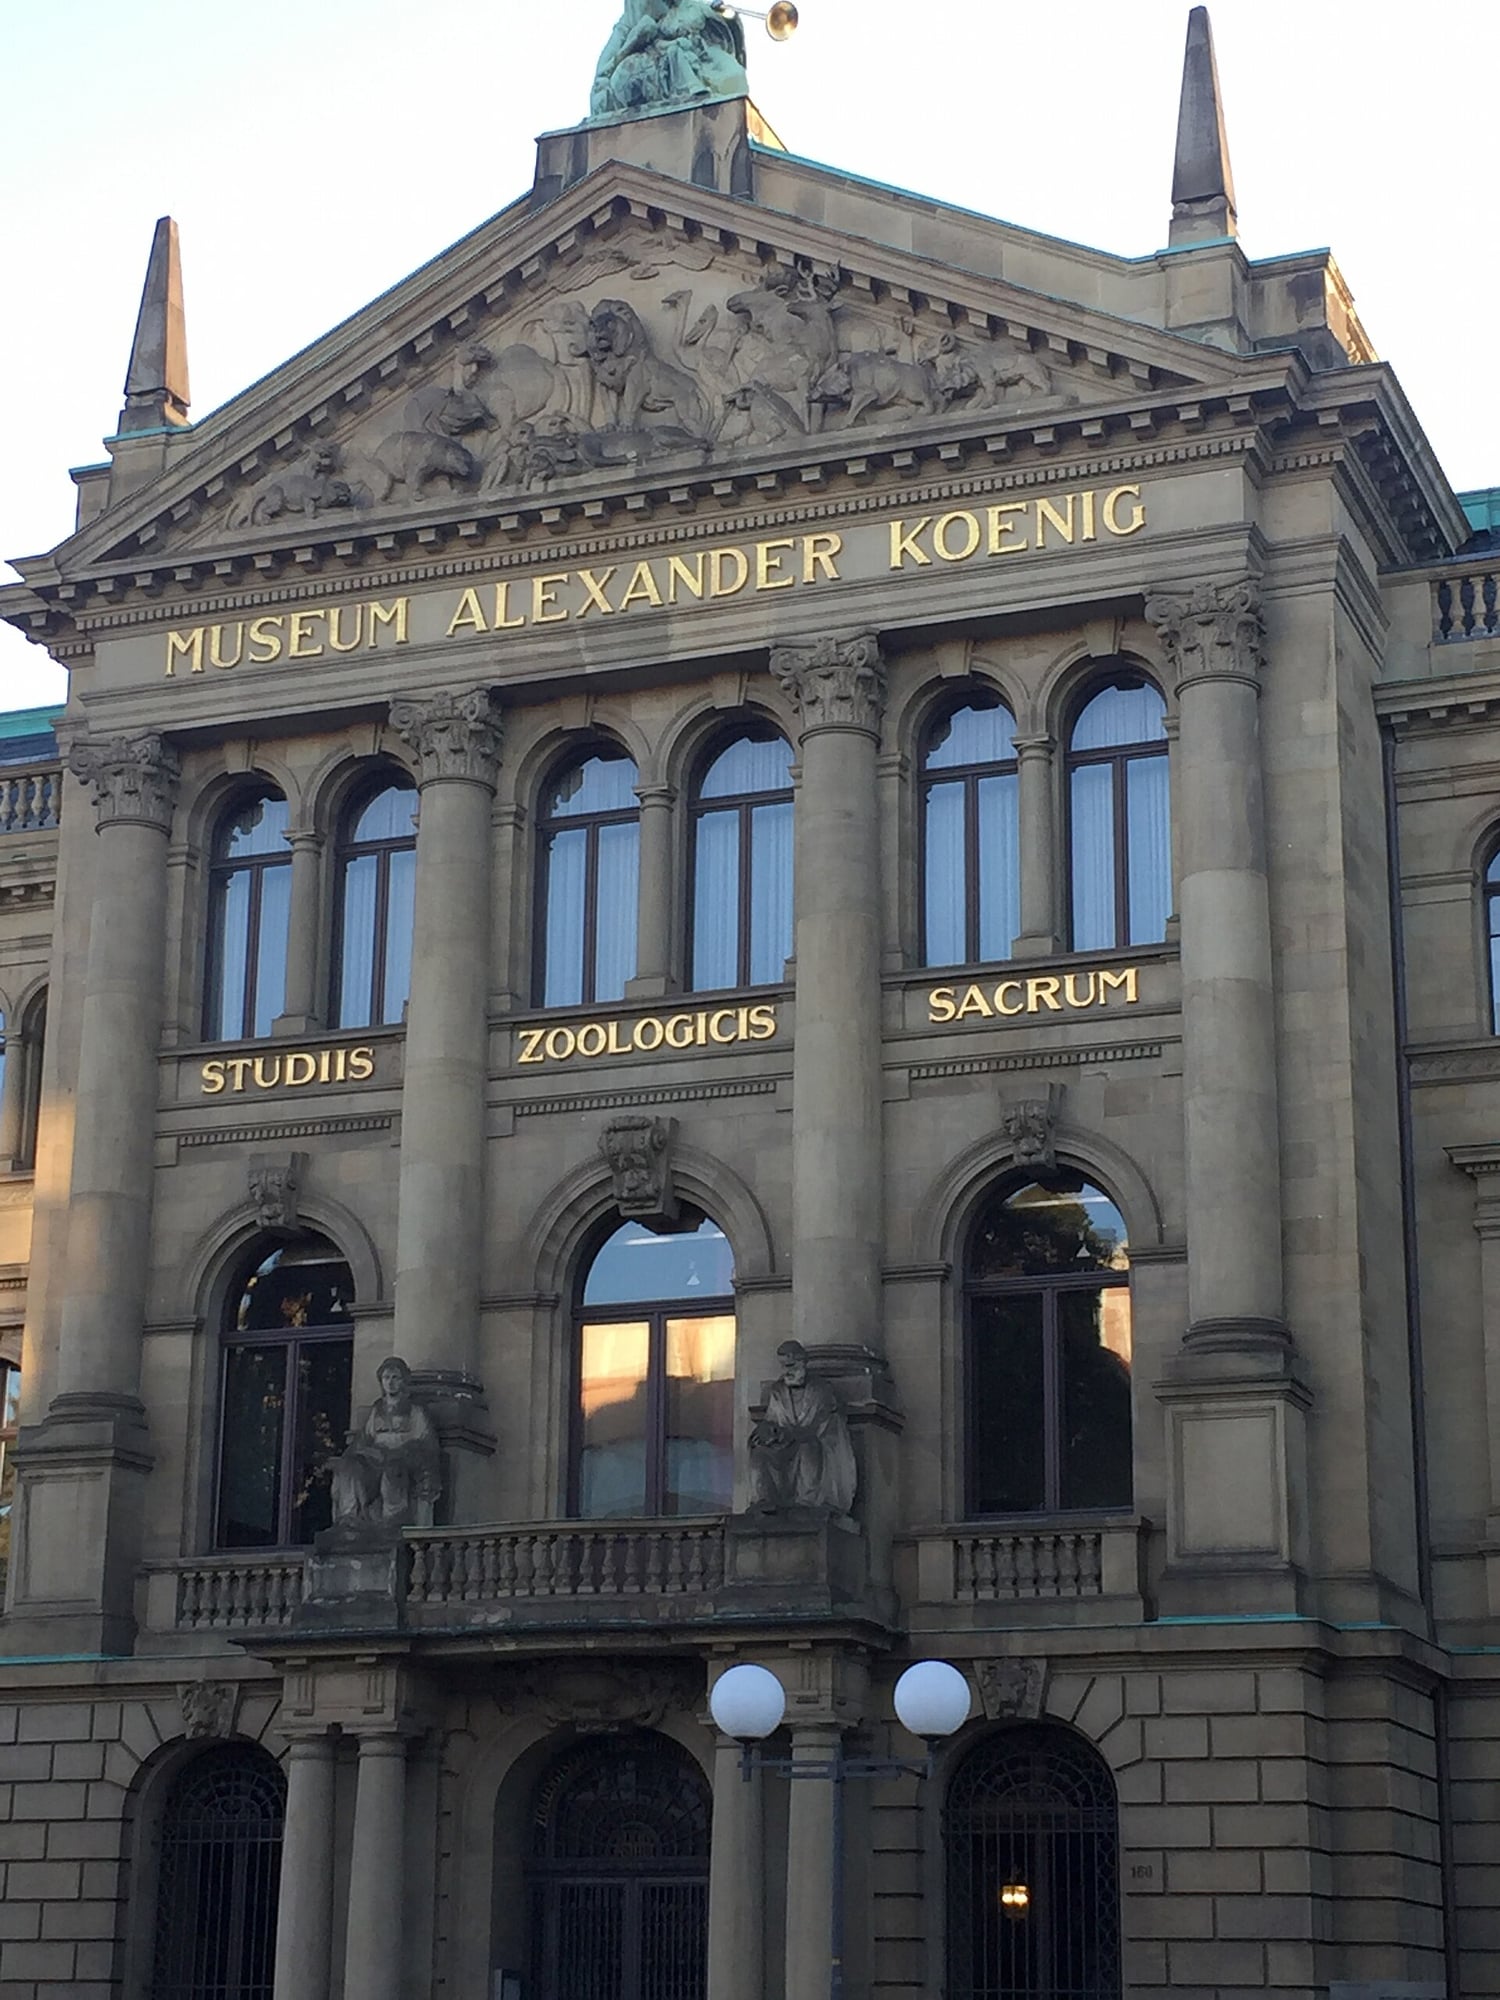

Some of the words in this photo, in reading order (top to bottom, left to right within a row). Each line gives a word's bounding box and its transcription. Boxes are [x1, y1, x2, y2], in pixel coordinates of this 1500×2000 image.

[165, 596, 410, 677] MUSEUM
[445, 532, 842, 637] ALEXANDER
[889, 484, 1146, 570] KOENIG
[201, 1046, 374, 1094] STUDIIS
[517, 1005, 776, 1064] ZOOLOGICIS
[928, 967, 1139, 1022] SACRUM
